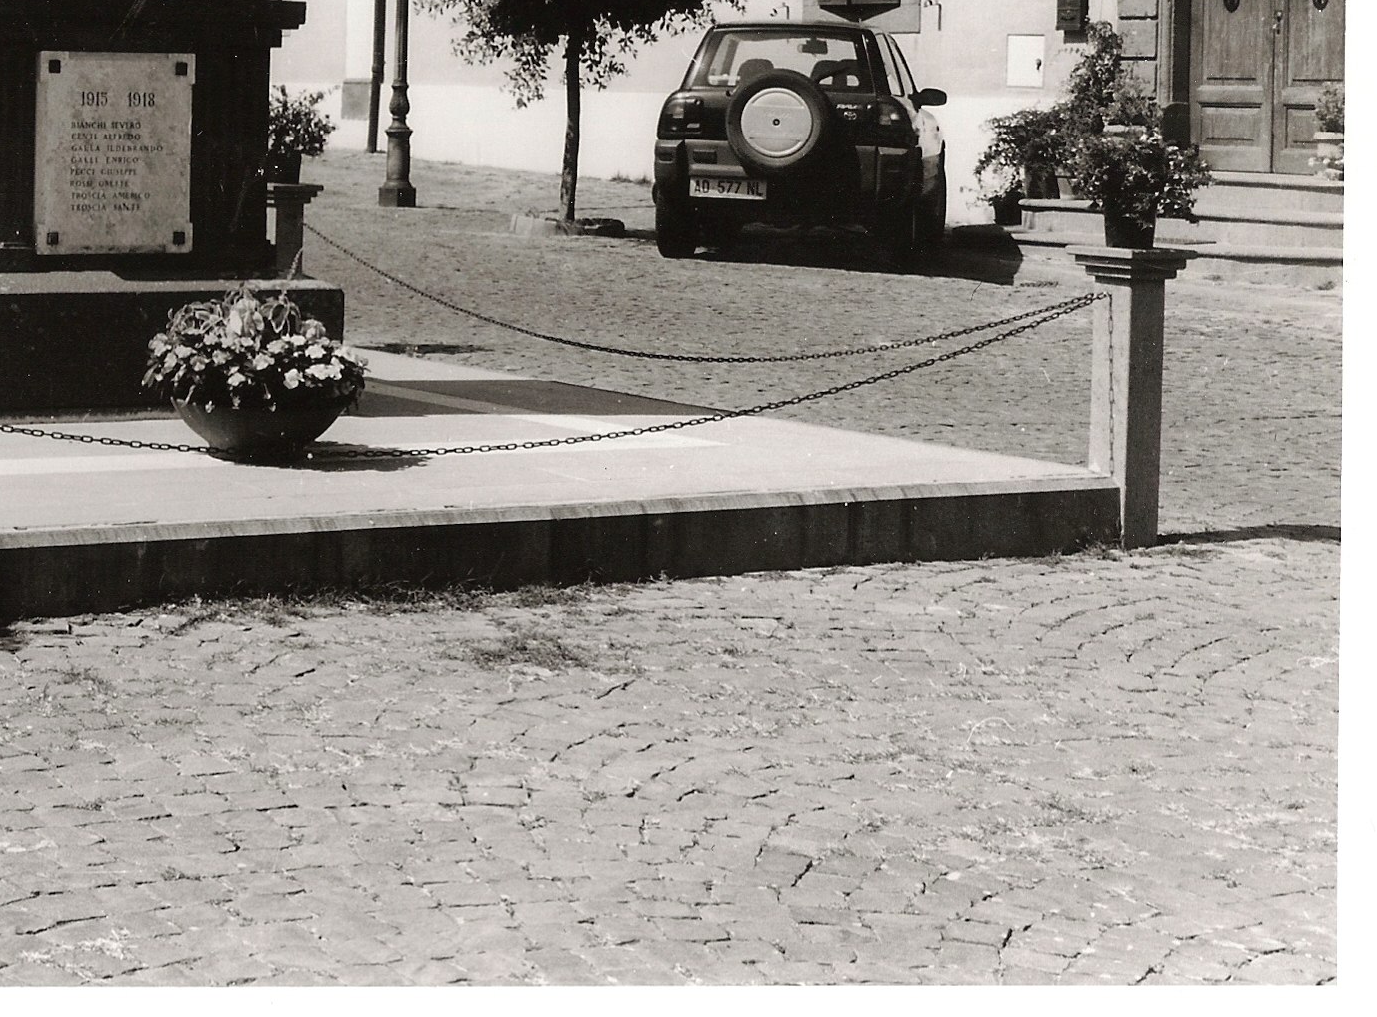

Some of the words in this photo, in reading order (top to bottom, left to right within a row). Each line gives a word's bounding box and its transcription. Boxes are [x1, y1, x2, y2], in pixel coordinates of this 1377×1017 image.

[80, 91, 108, 107] 1915
[127, 91, 156, 108] 1918
[71, 121, 107, 130] BIANCHI
[111, 121, 141, 130] SEVERO
[107, 144, 163, 152] ILDEBRANDO
[106, 156, 139, 164] ENRICO
[100, 168, 137, 176] GIUSEPPE
[717, 180, 742, 194] 577
[746, 182, 763, 196] NL
[112, 191, 150, 200] AMERICO
